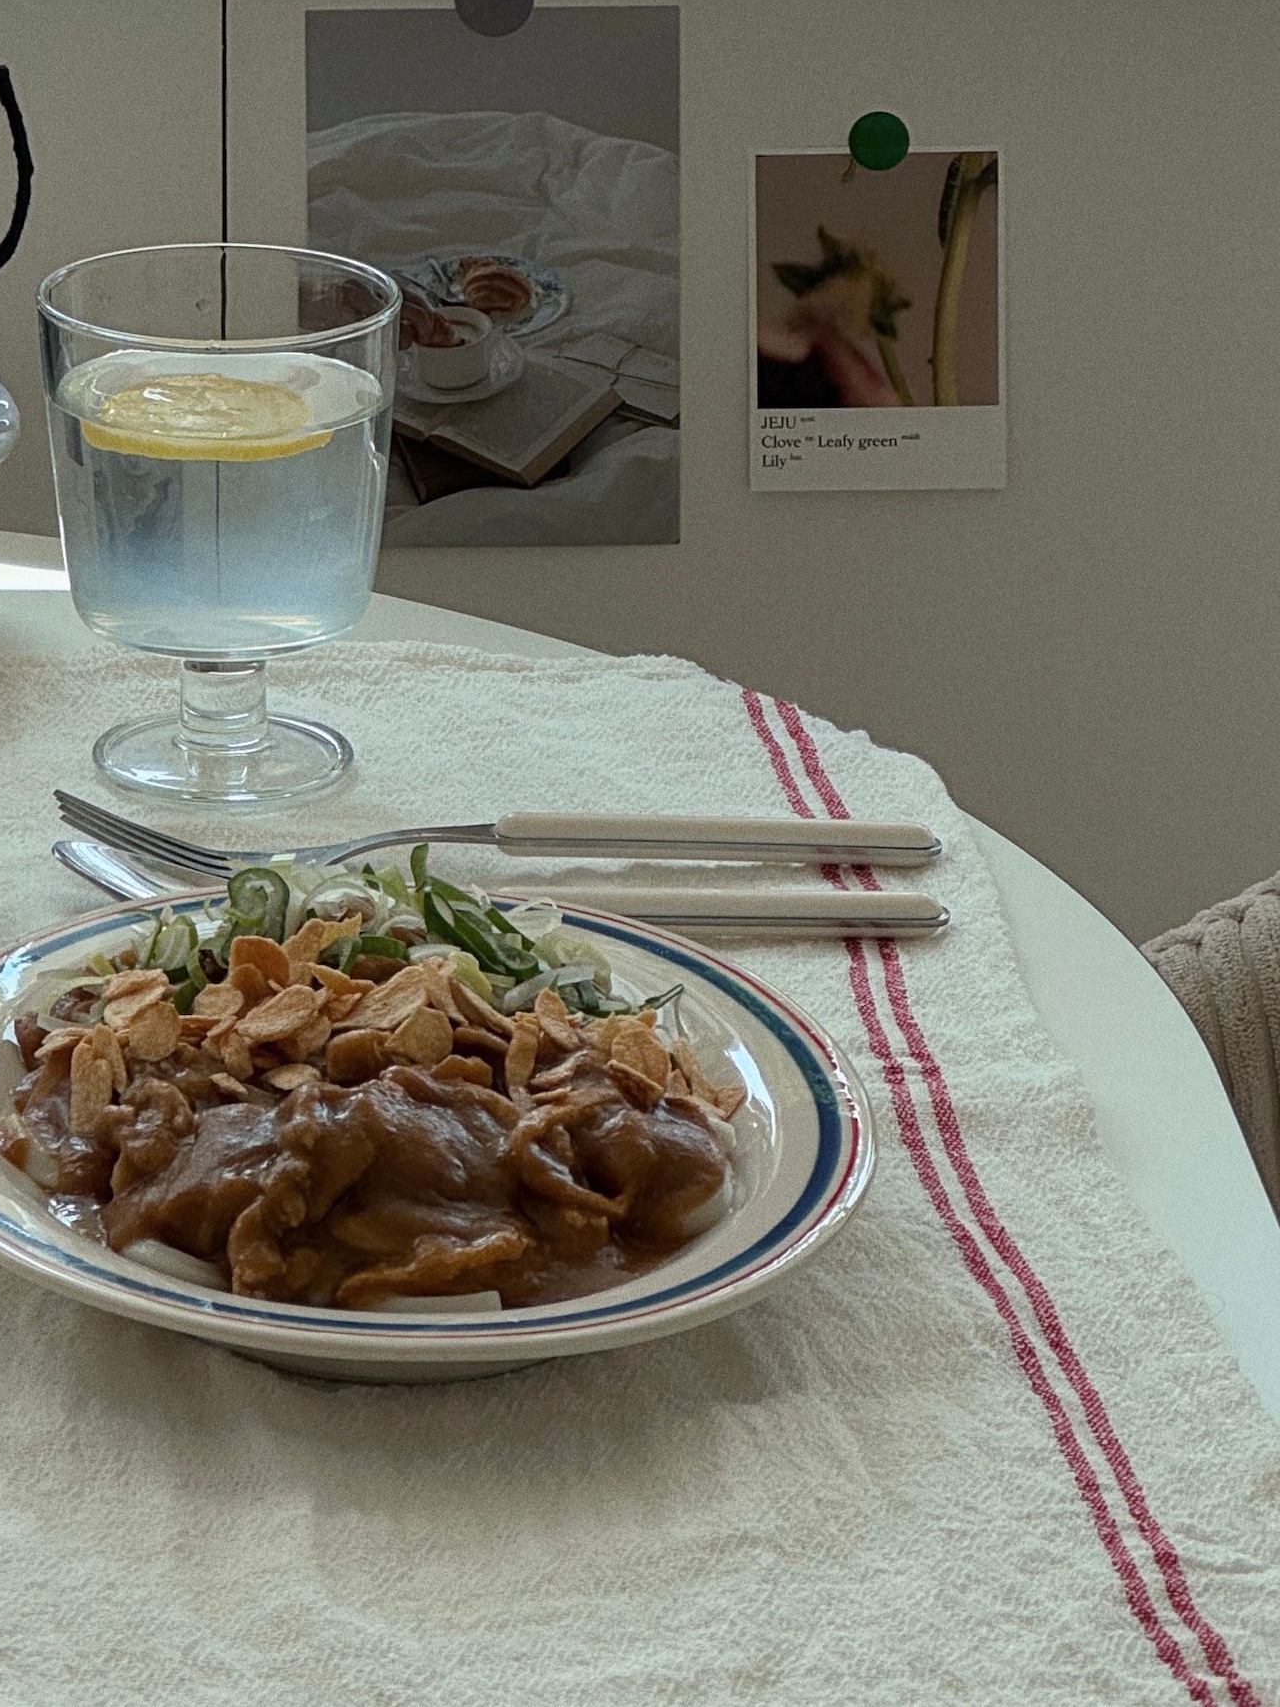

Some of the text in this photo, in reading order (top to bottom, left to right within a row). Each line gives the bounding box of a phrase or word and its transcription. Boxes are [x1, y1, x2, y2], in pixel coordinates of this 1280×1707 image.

[760, 415, 797, 429] JEJU
[761, 434, 898, 450] Clove Leafy green
[762, 454, 787, 469] Lily
